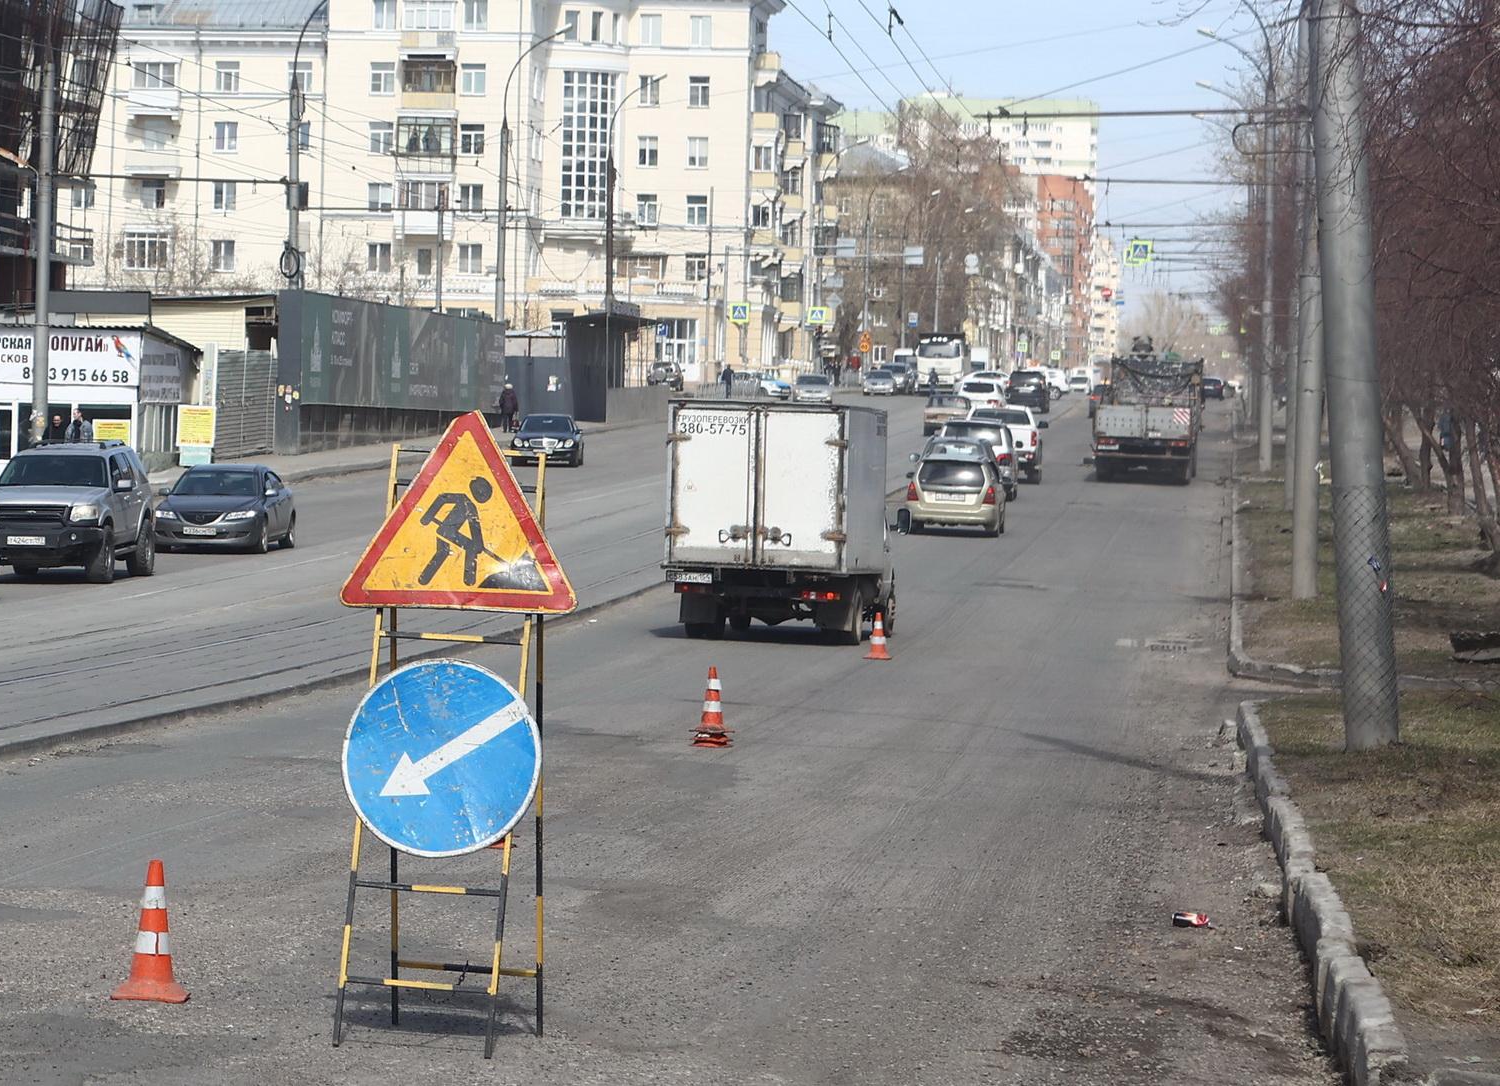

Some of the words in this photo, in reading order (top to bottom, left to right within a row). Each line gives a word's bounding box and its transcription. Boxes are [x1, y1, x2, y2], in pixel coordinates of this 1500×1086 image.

[47, 335, 109, 352] ОПУГАЙ»
[61, 368, 86, 382] 915
[91, 369, 107, 382] 66
[112, 370, 129, 383] 58
[677, 414, 749, 424] ГРУЗОПЕРЕВОЗКИ
[680, 422, 747, 436] 380-57-75
